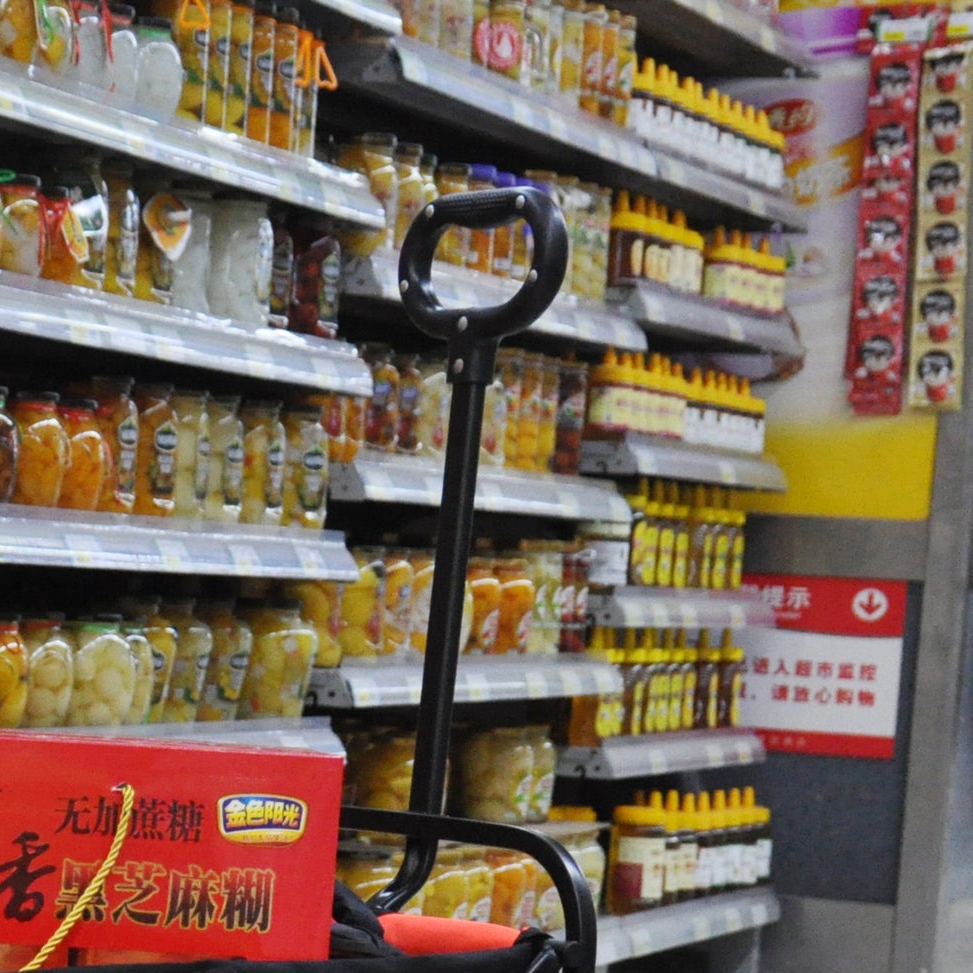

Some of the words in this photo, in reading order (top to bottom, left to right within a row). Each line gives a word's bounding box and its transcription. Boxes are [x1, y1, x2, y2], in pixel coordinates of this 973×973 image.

[55, 796, 205, 843] 无加蔗糖
[223, 799, 299, 829] 金色阳光
[55, 858, 276, 934] 黑芝麻糊
